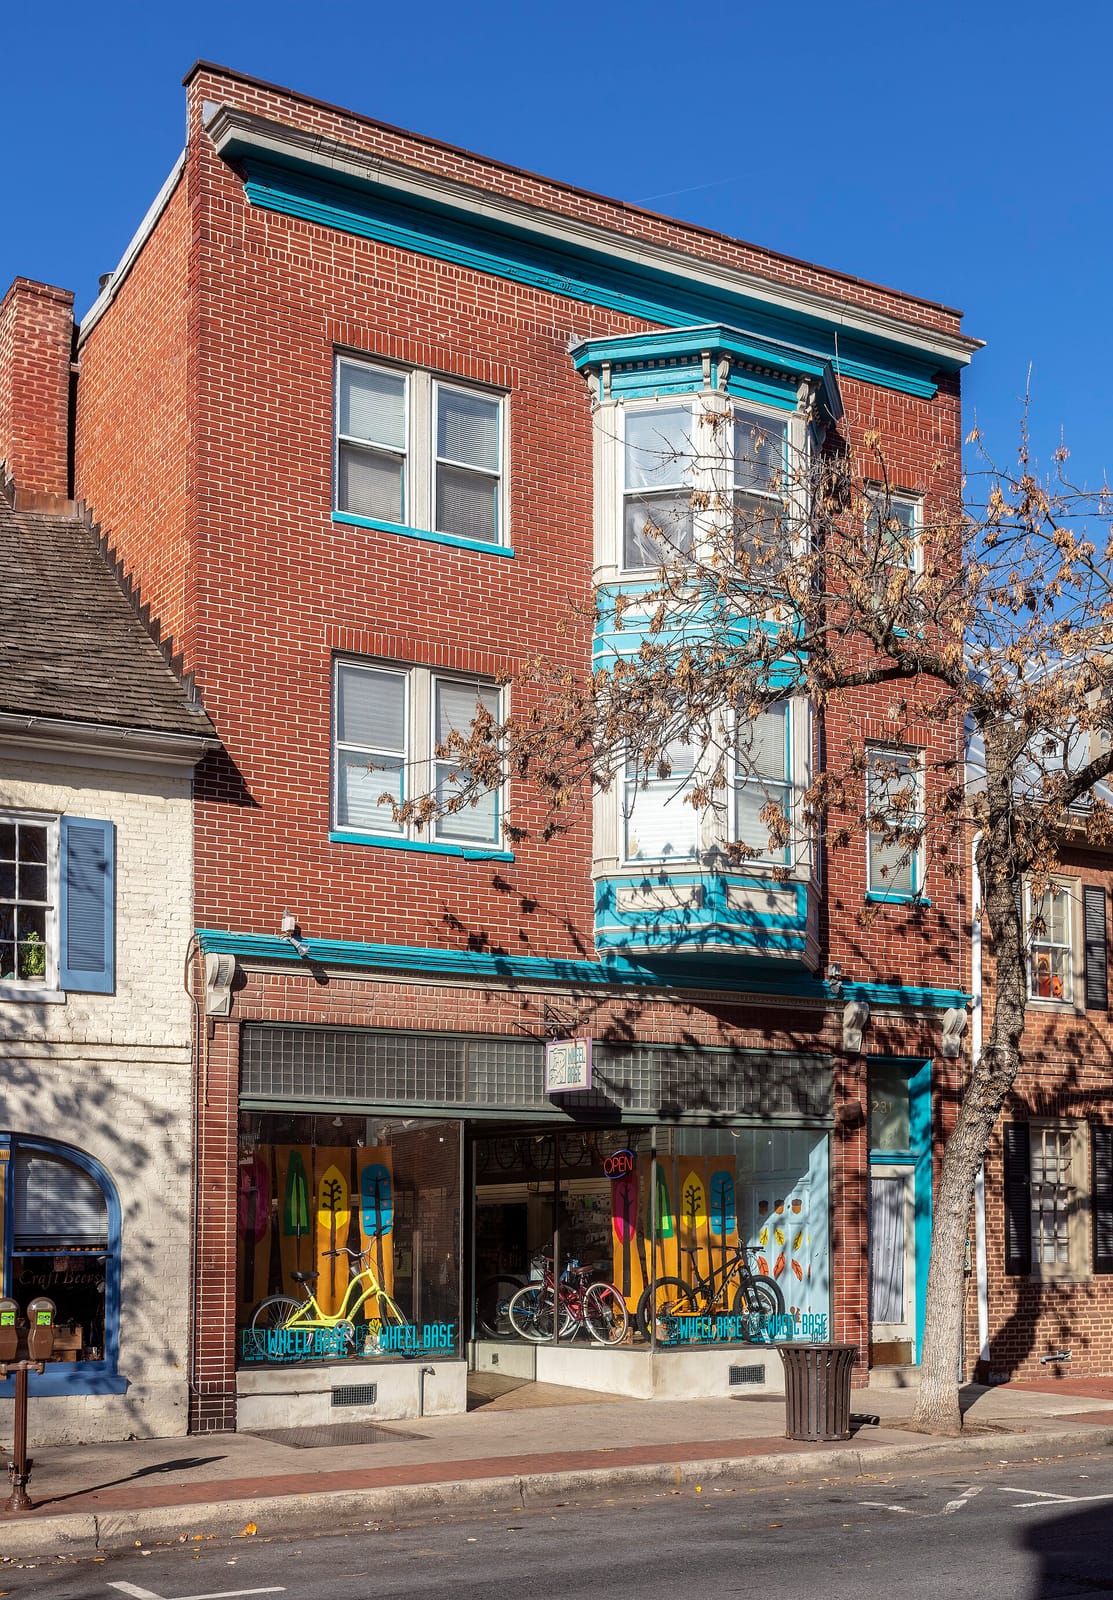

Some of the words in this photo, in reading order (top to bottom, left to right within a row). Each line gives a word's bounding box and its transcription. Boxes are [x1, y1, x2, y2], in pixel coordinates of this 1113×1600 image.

[567, 1046, 586, 1064] WHEEL
[567, 1065, 582, 1084] BASE
[871, 1100, 892, 1113] 231
[603, 1155, 633, 1174] OPEN
[19, 1269, 58, 1289] Craft
[63, 1269, 101, 1284] Beers
[680, 1316, 714, 1339] WHEEL
[716, 1315, 743, 1338] BASE
[767, 1314, 800, 1336] WHEEL
[802, 1313, 827, 1335] BASE
[268, 1329, 311, 1354] WHEEL
[314, 1328, 348, 1353] BASE
[379, 1324, 420, 1350] WHEEL
[423, 1323, 455, 1348] BASE
